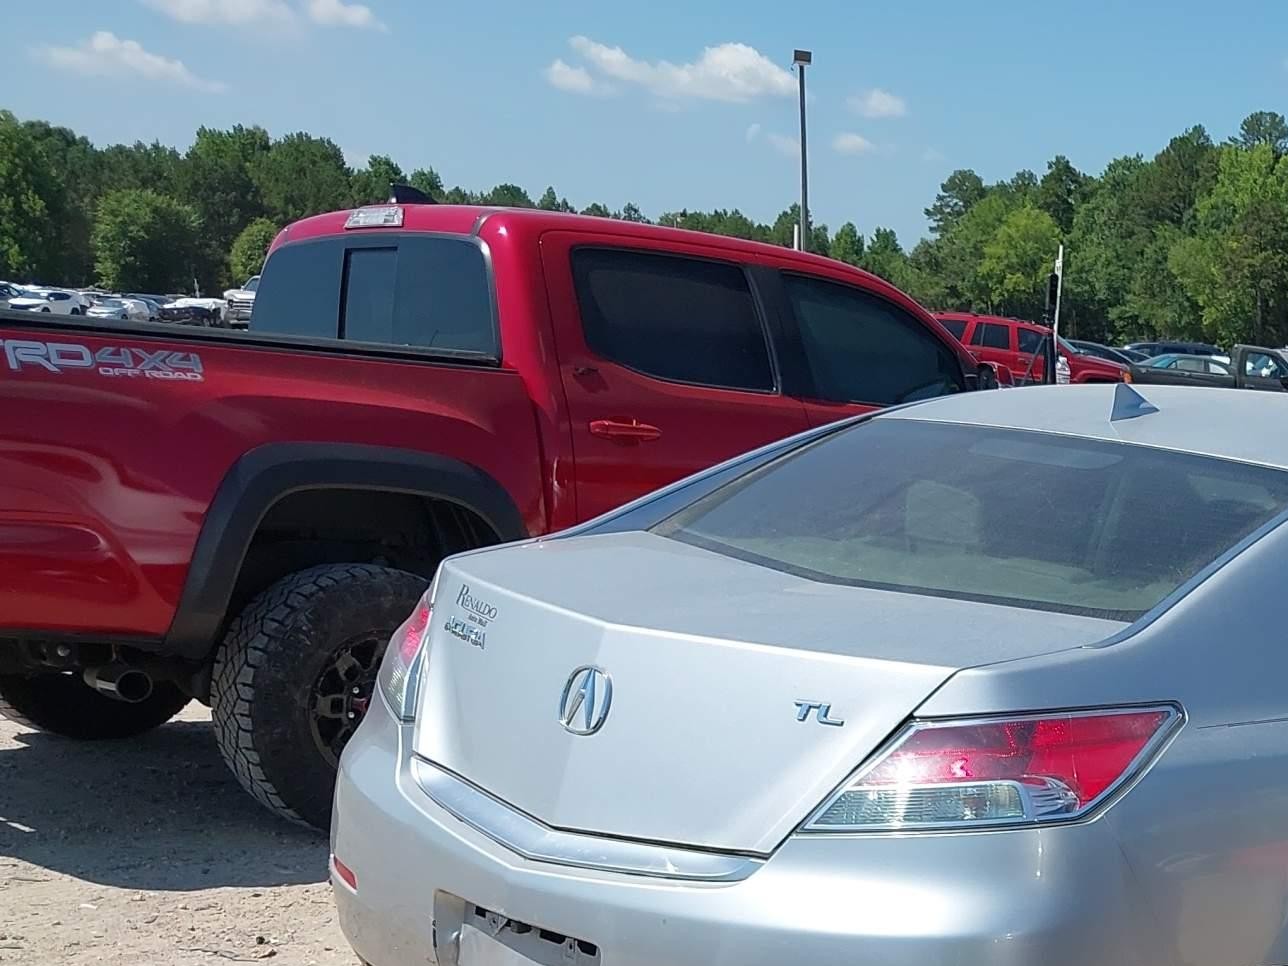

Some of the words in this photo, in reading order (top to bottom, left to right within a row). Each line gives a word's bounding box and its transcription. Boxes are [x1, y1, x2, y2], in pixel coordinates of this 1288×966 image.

[98, 367, 140, 377] OFF
[145, 370, 204, 381] ROAD
[455, 583, 498, 619] RENALDO
[793, 698, 845, 727] TL
